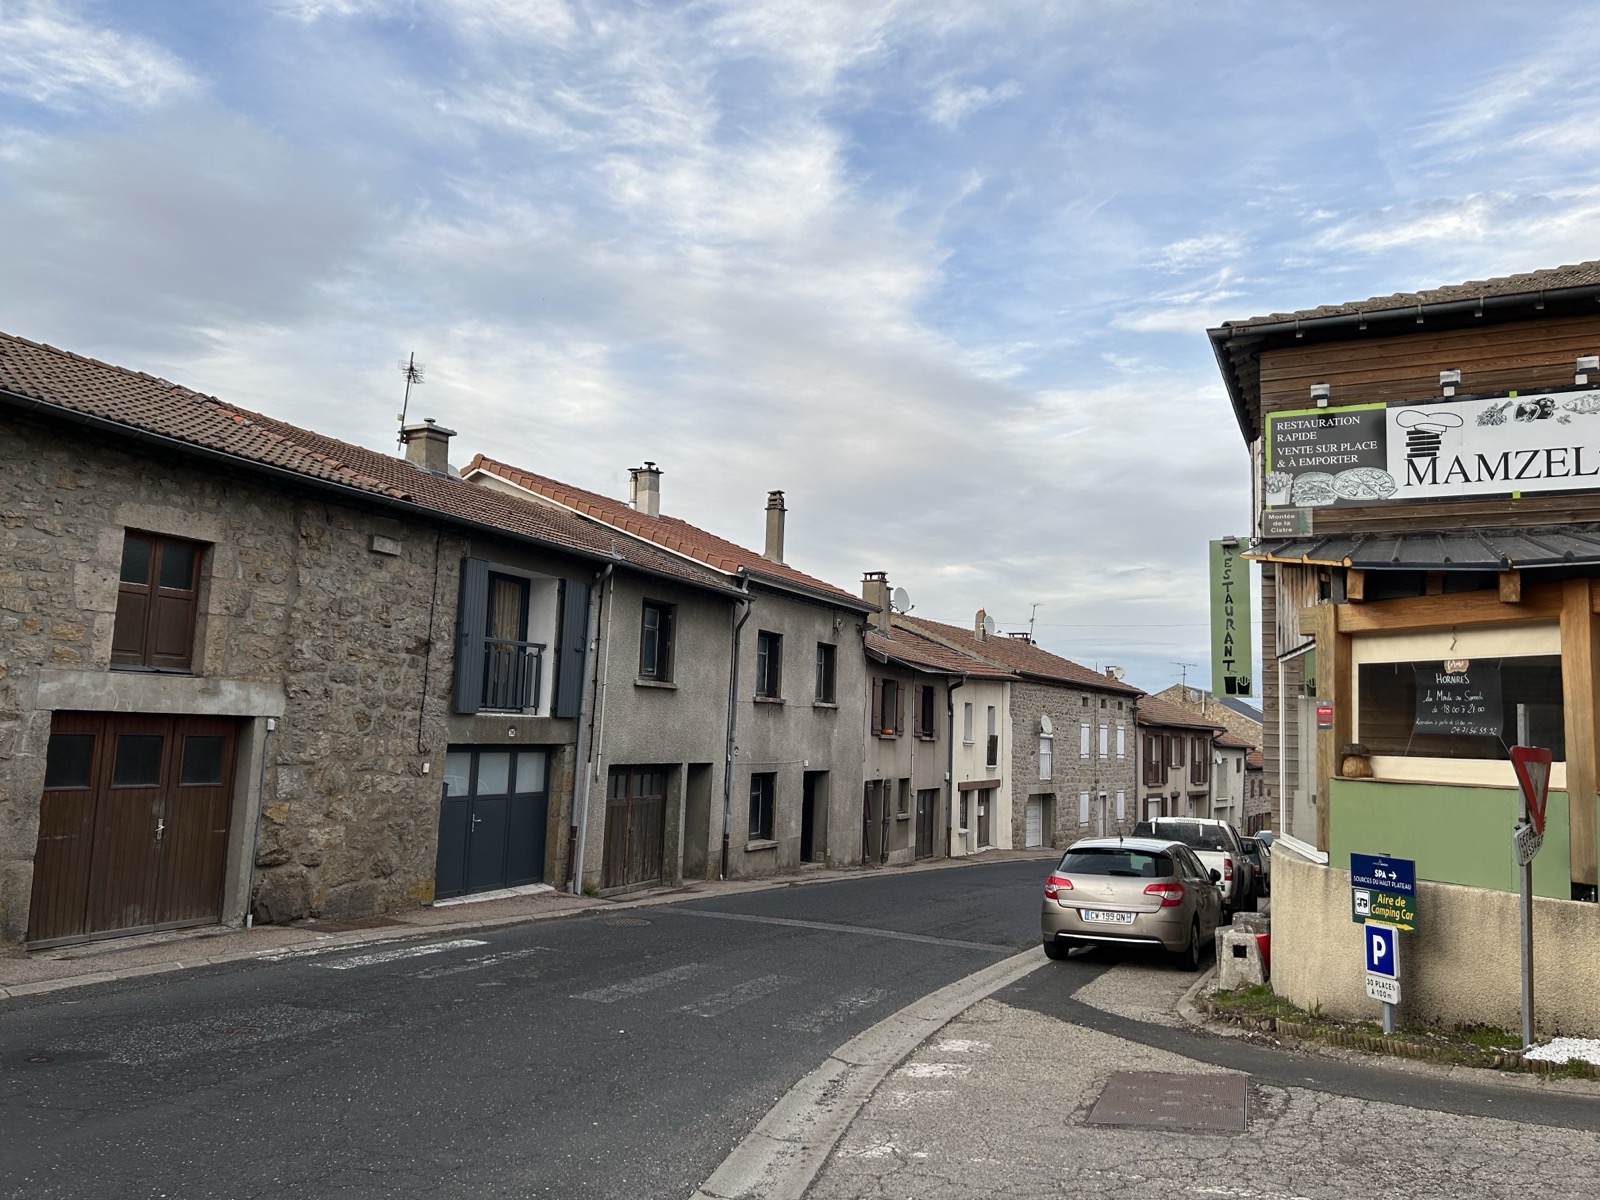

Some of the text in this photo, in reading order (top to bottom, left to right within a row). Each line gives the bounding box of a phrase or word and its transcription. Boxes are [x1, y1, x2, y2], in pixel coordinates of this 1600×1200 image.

[1277, 416, 1360, 430] RESTAURATION
[1277, 431, 1318, 442] RAPIDE
[1277, 441, 1378, 456] VENTE SUR PLACE
[1276, 454, 1359, 468] & À EMPORTER
[1403, 446, 1600, 487] MAMZEL
[1374, 869, 1387, 879] SPA
[1353, 875, 1372, 884] SOURCES
[1379, 879, 1391, 887] HAUT
[1391, 881, 1412, 891] PLATEAU
[1377, 893, 1406, 908] Aire de
[1371, 904, 1414, 921] Camping Car
[1372, 934, 1387, 966] P
[1375, 980, 1396, 991] PLACES
